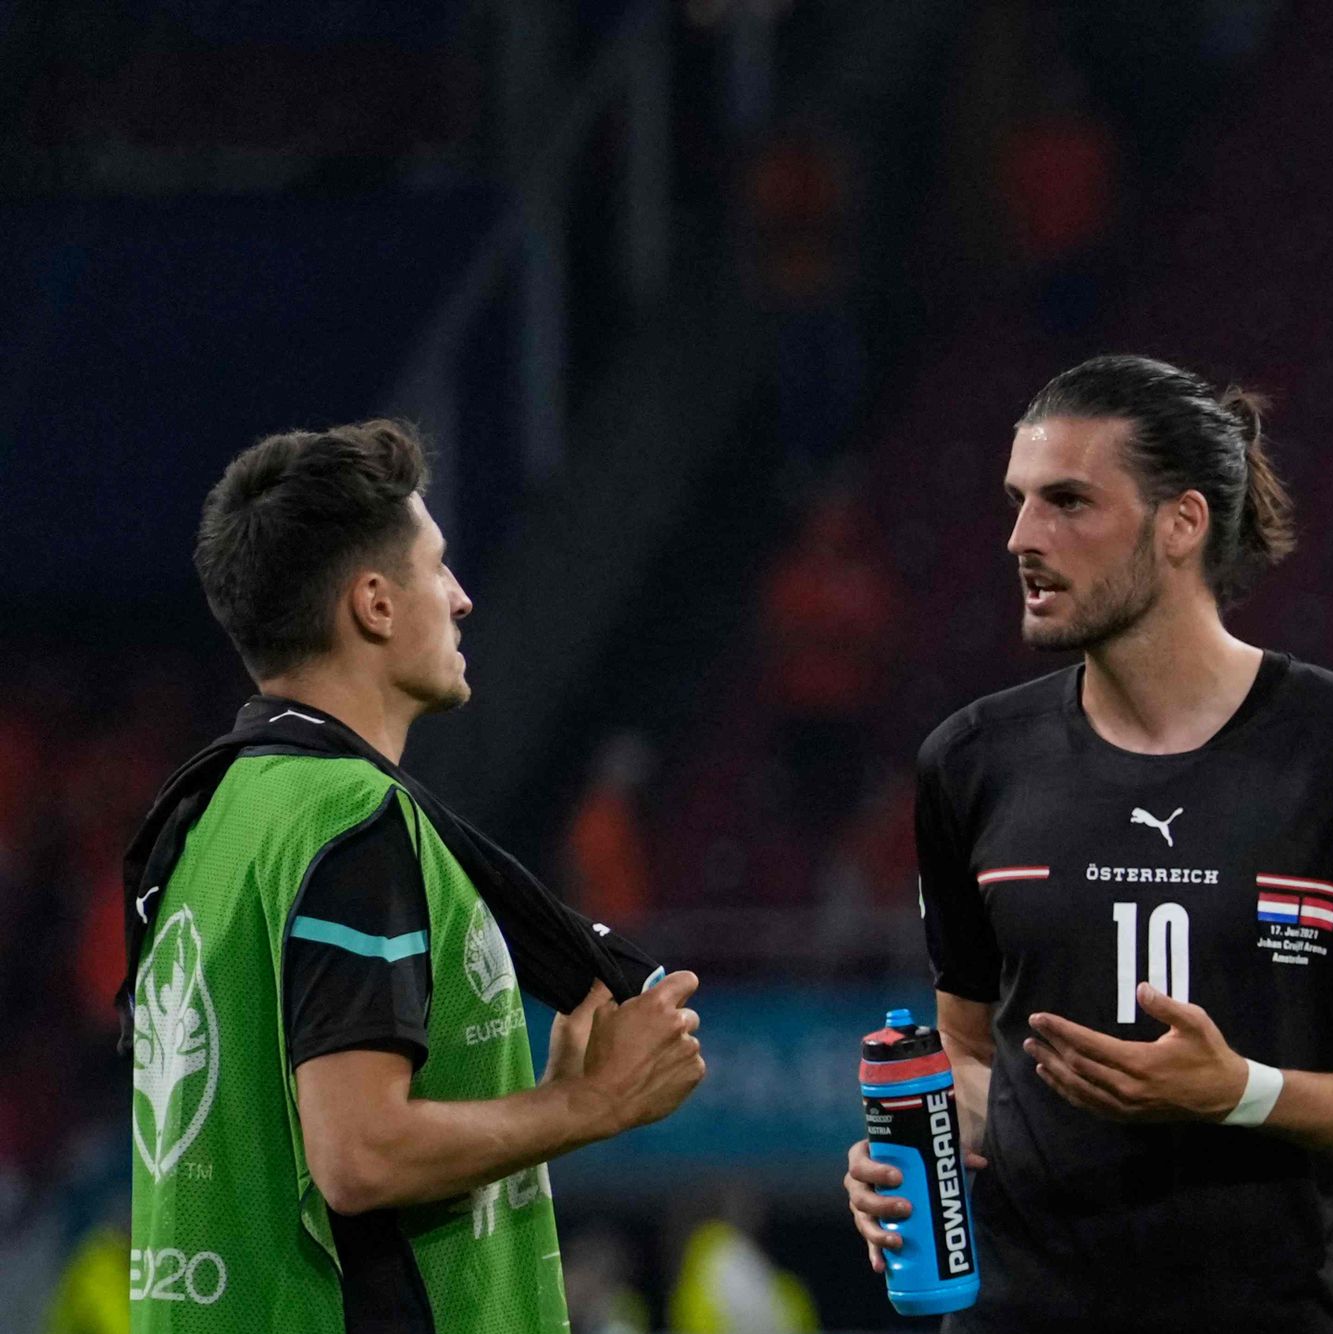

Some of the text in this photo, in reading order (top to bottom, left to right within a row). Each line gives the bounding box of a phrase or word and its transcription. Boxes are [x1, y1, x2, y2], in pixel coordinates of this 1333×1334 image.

[1085, 863, 1220, 885] ÖSTERREICH
[1112, 902, 1190, 1024] 10
[926, 1091, 971, 1275] POWERADE
